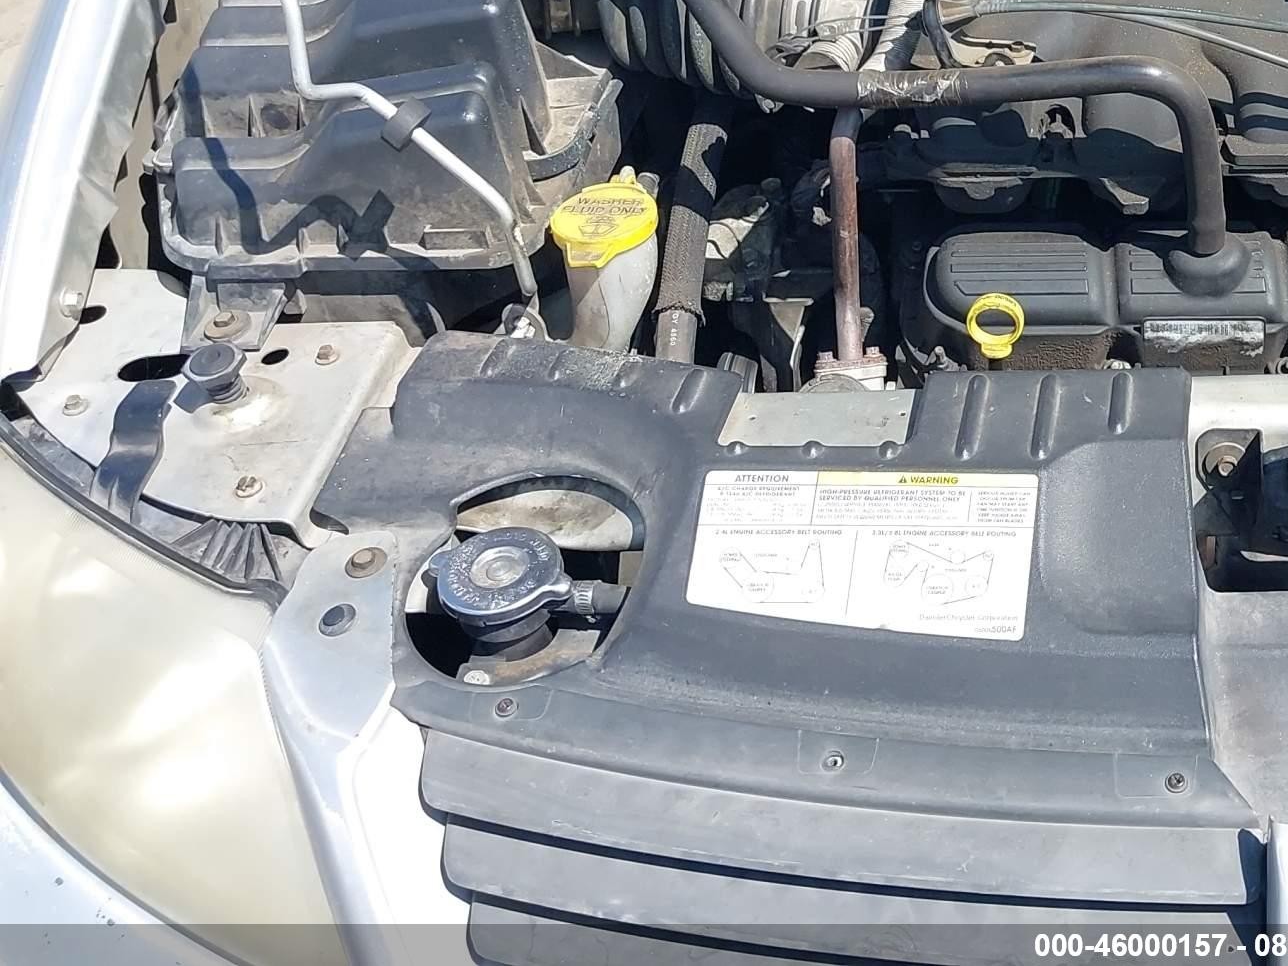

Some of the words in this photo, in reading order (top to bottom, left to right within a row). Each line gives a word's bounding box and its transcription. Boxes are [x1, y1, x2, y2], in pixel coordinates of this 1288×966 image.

[578, 197, 645, 206] WASHER
[560, 205, 606, 214] FLUID
[608, 205, 648, 215] ONLY
[734, 474, 790, 483] ATTENTION
[910, 476, 959, 485] WARNING
